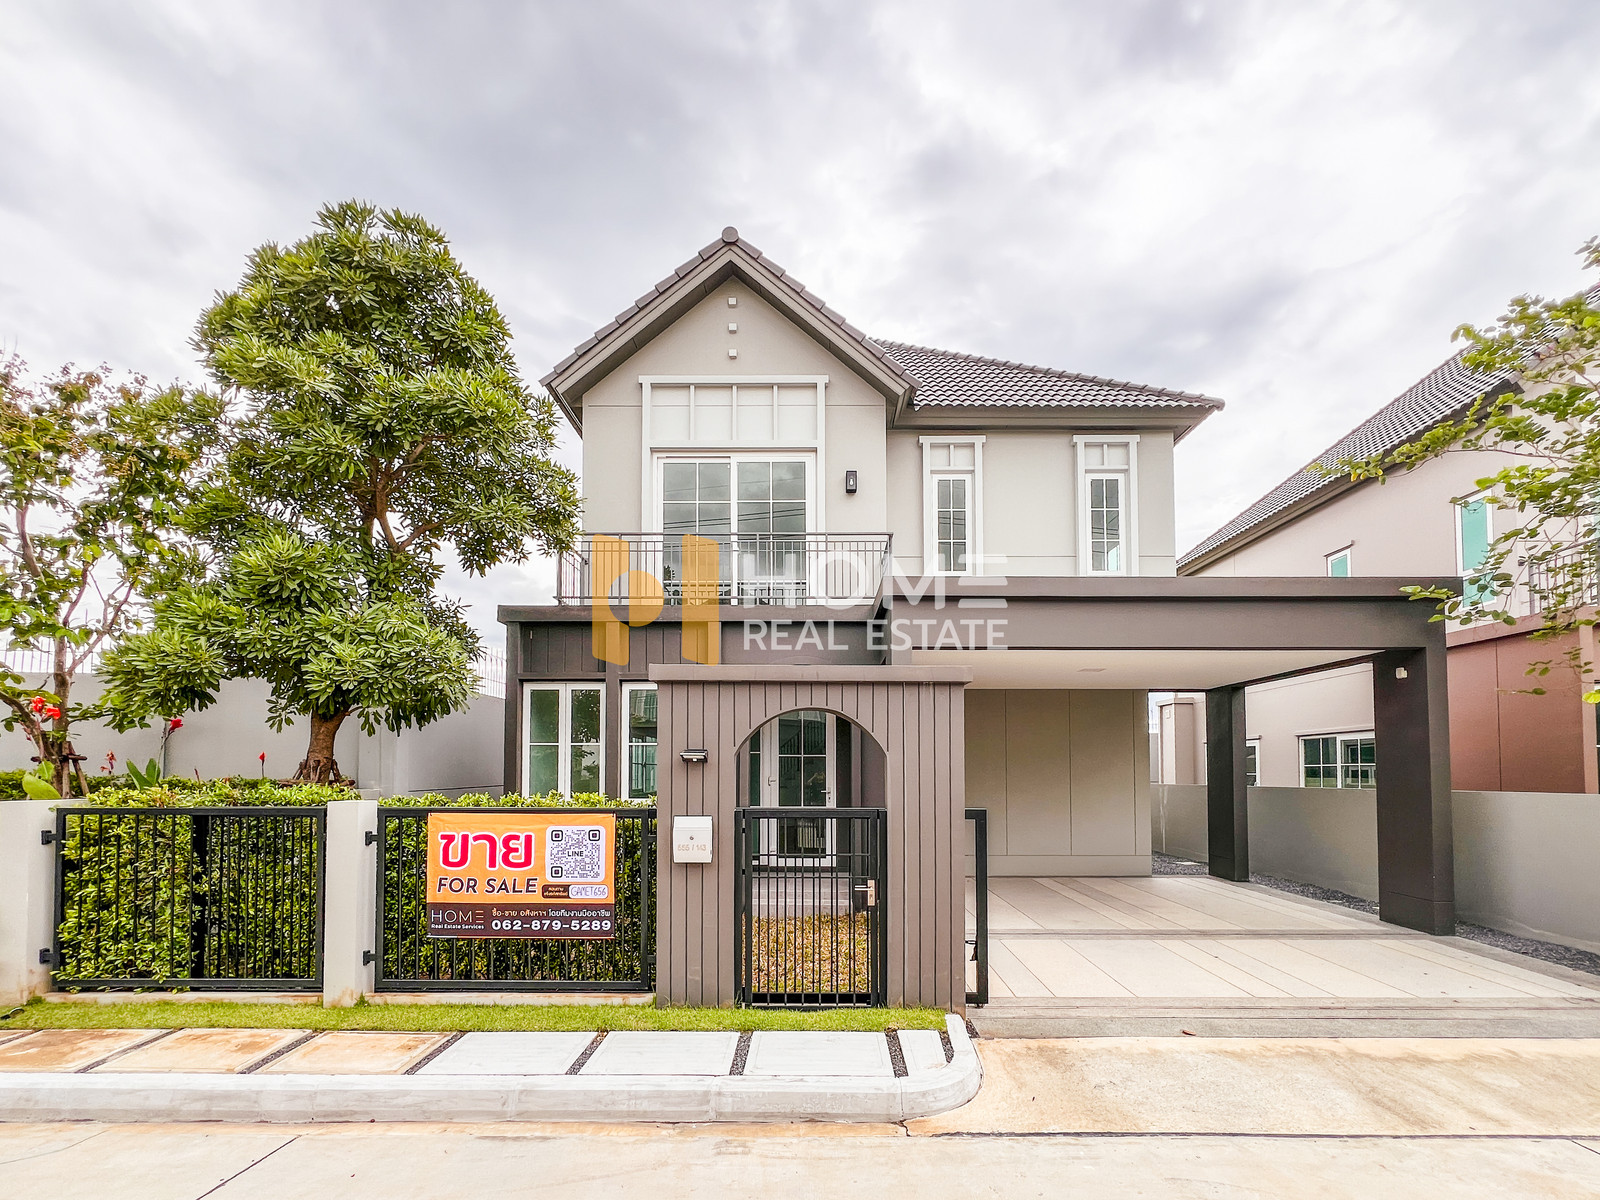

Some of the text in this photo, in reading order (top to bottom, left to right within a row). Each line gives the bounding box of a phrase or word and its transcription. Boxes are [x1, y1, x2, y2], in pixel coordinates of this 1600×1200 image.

[439, 833, 534, 869] ขาย
[437, 877, 538, 894] FOR SALE
[431, 909, 484, 923] HOME
[491, 919, 611, 931] 062-879-5289
